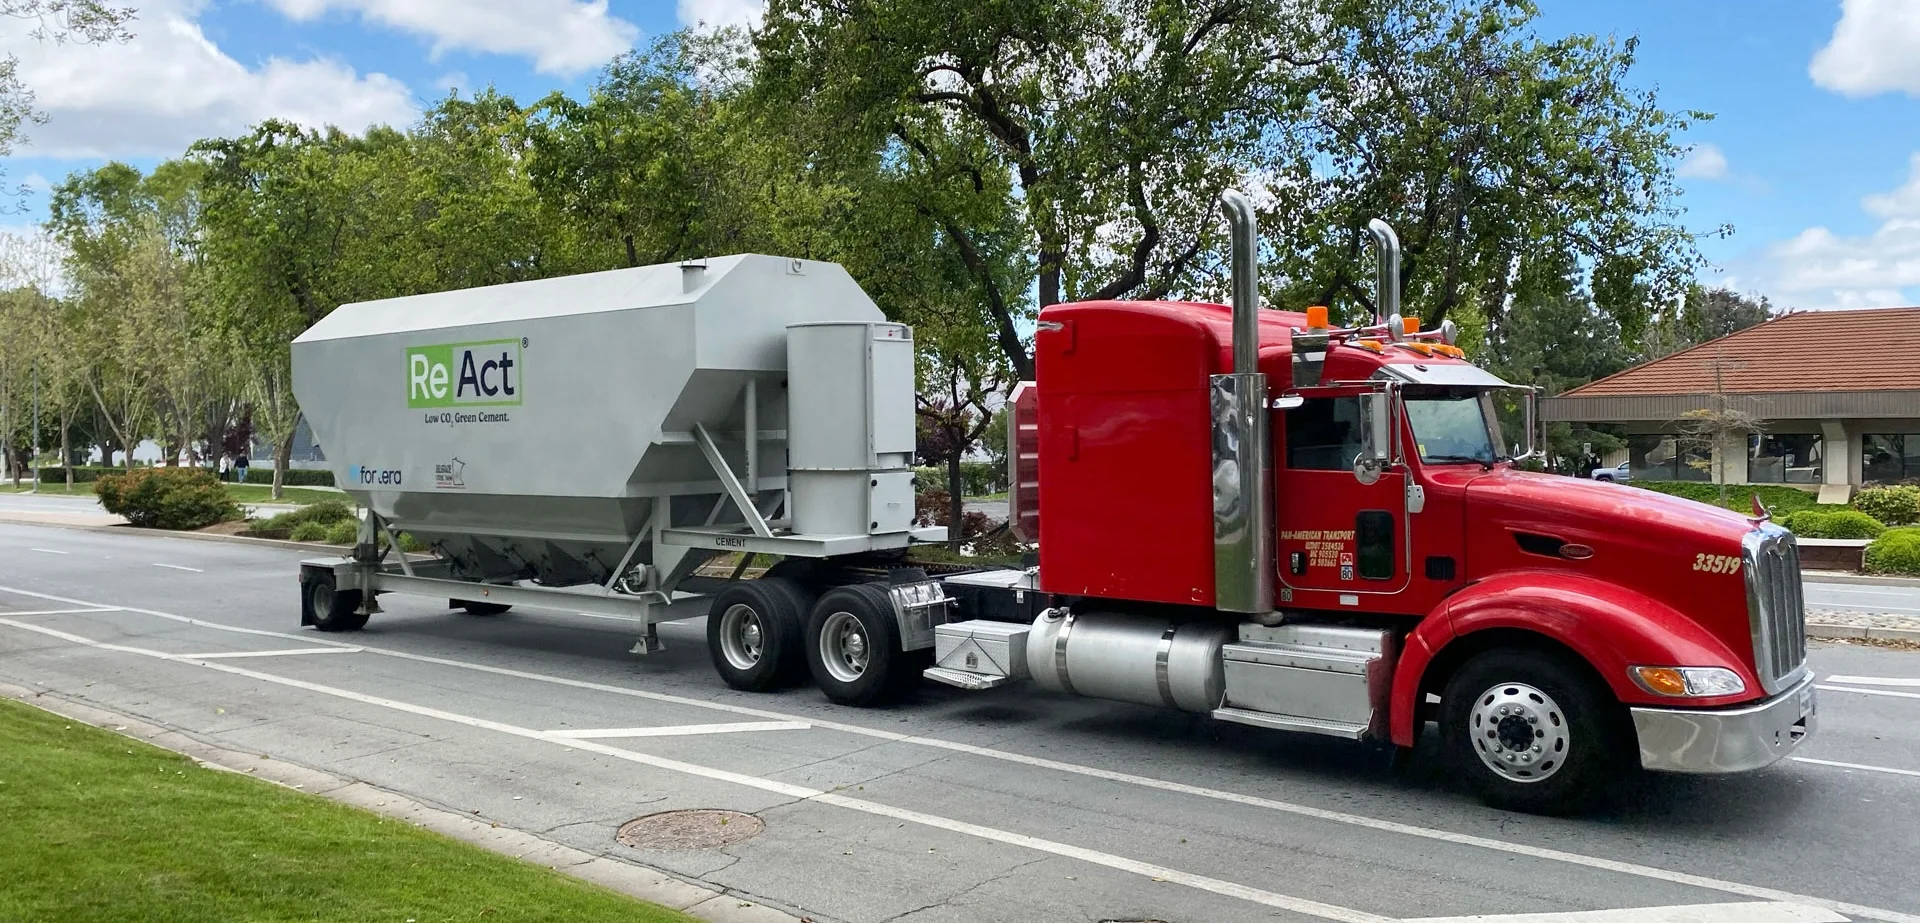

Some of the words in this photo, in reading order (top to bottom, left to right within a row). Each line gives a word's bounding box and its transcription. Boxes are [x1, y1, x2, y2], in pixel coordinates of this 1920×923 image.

[424, 413, 439, 424] Low
[454, 412, 477, 423] Green
[478, 411, 510, 423] Cement.
[1280, 530, 1322, 540] PAN-AMERICAN
[1323, 530, 1355, 541] TRANSPORT
[715, 537, 746, 548] CEMENT
[1692, 552, 1742, 575] 33519
[1342, 569, 1352, 580] 80
[1282, 591, 1292, 601] 80
